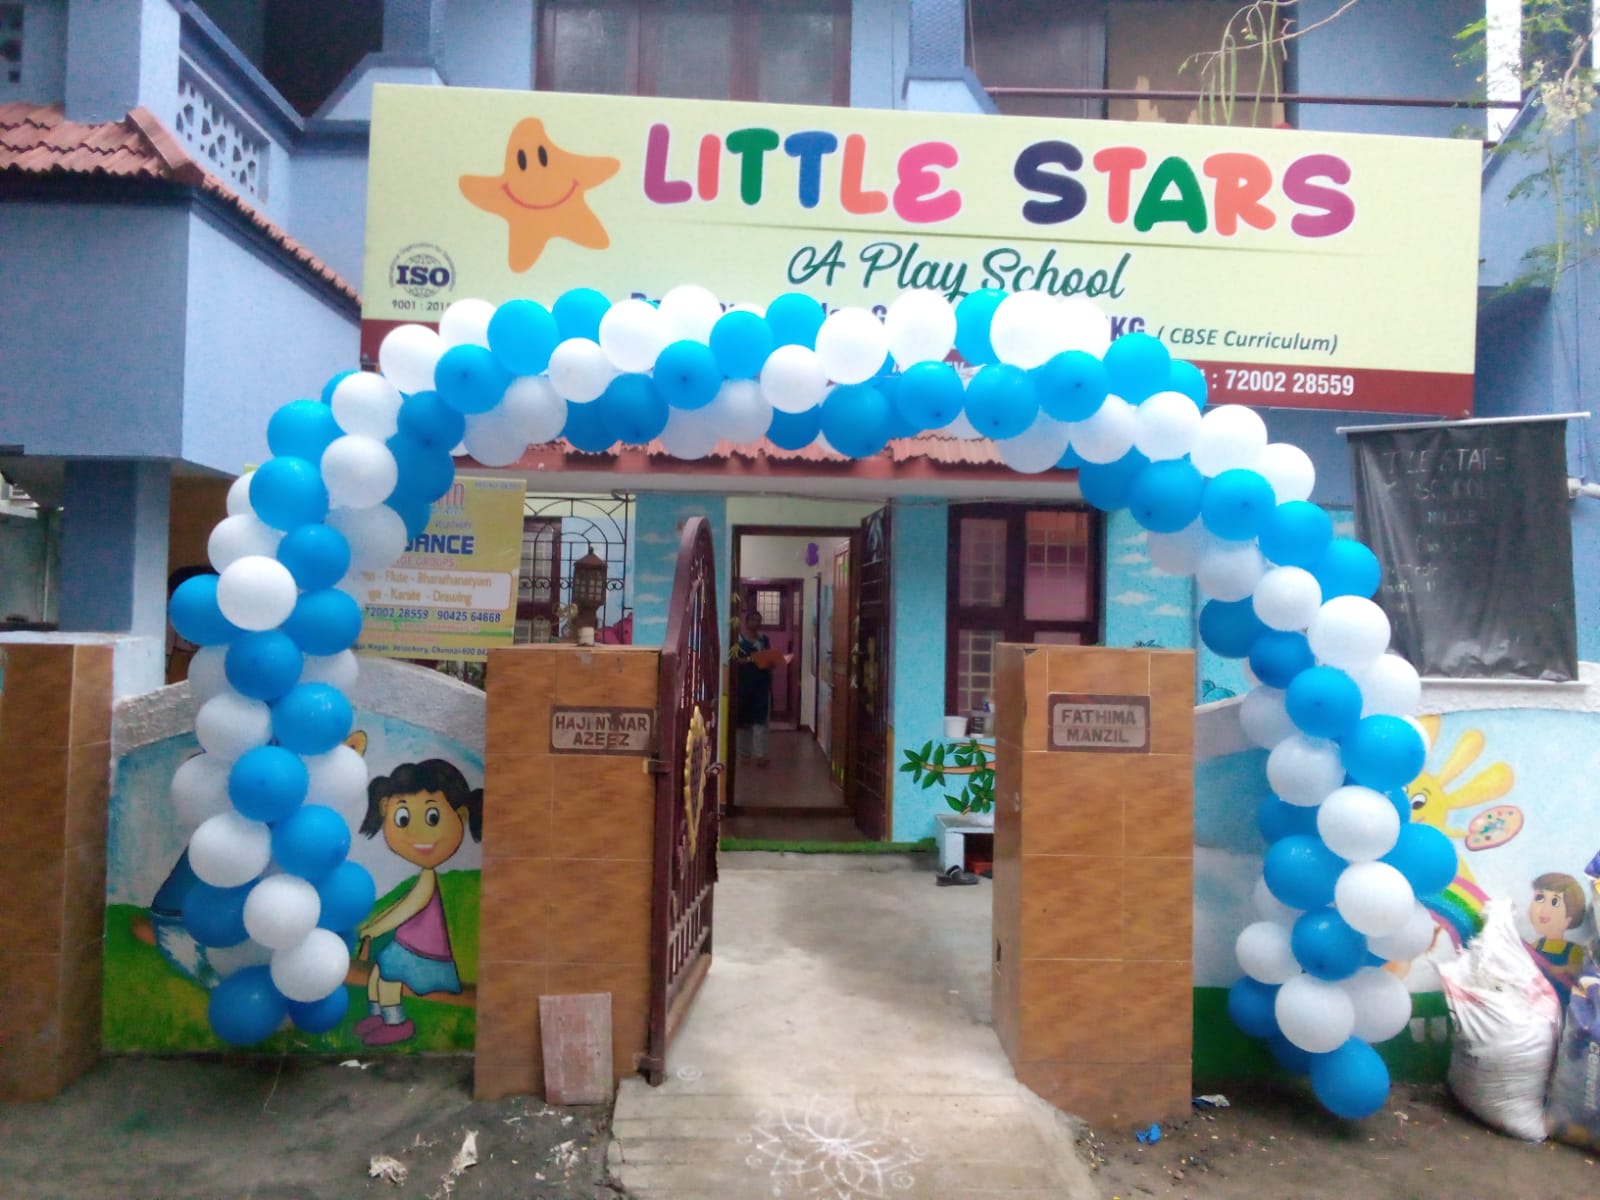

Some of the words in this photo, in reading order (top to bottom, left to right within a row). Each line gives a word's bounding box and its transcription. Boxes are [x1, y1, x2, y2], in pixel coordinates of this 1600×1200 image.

[644, 123, 961, 222] LITTLE
[1014, 140, 1355, 237] STARS
[395, 264, 450, 287] ISO
[787, 240, 846, 287] A
[859, 241, 968, 304] Play
[981, 247, 1132, 299] School
[1107, 315, 1146, 342] KG
[1223, 330, 1339, 355] Curriculum)
[1225, 369, 1286, 392] 72002
[1293, 371, 1355, 396] 28559
[398, 609, 429, 620] 28559
[437, 611, 468, 622] 90425
[471, 612, 501, 623] 64668
[555, 715, 592, 730] HAJI
[1061, 708, 1137, 725] FATHIMA
[573, 732, 630, 746] AZEEZ
[1066, 728, 1130, 744] MANZIL
